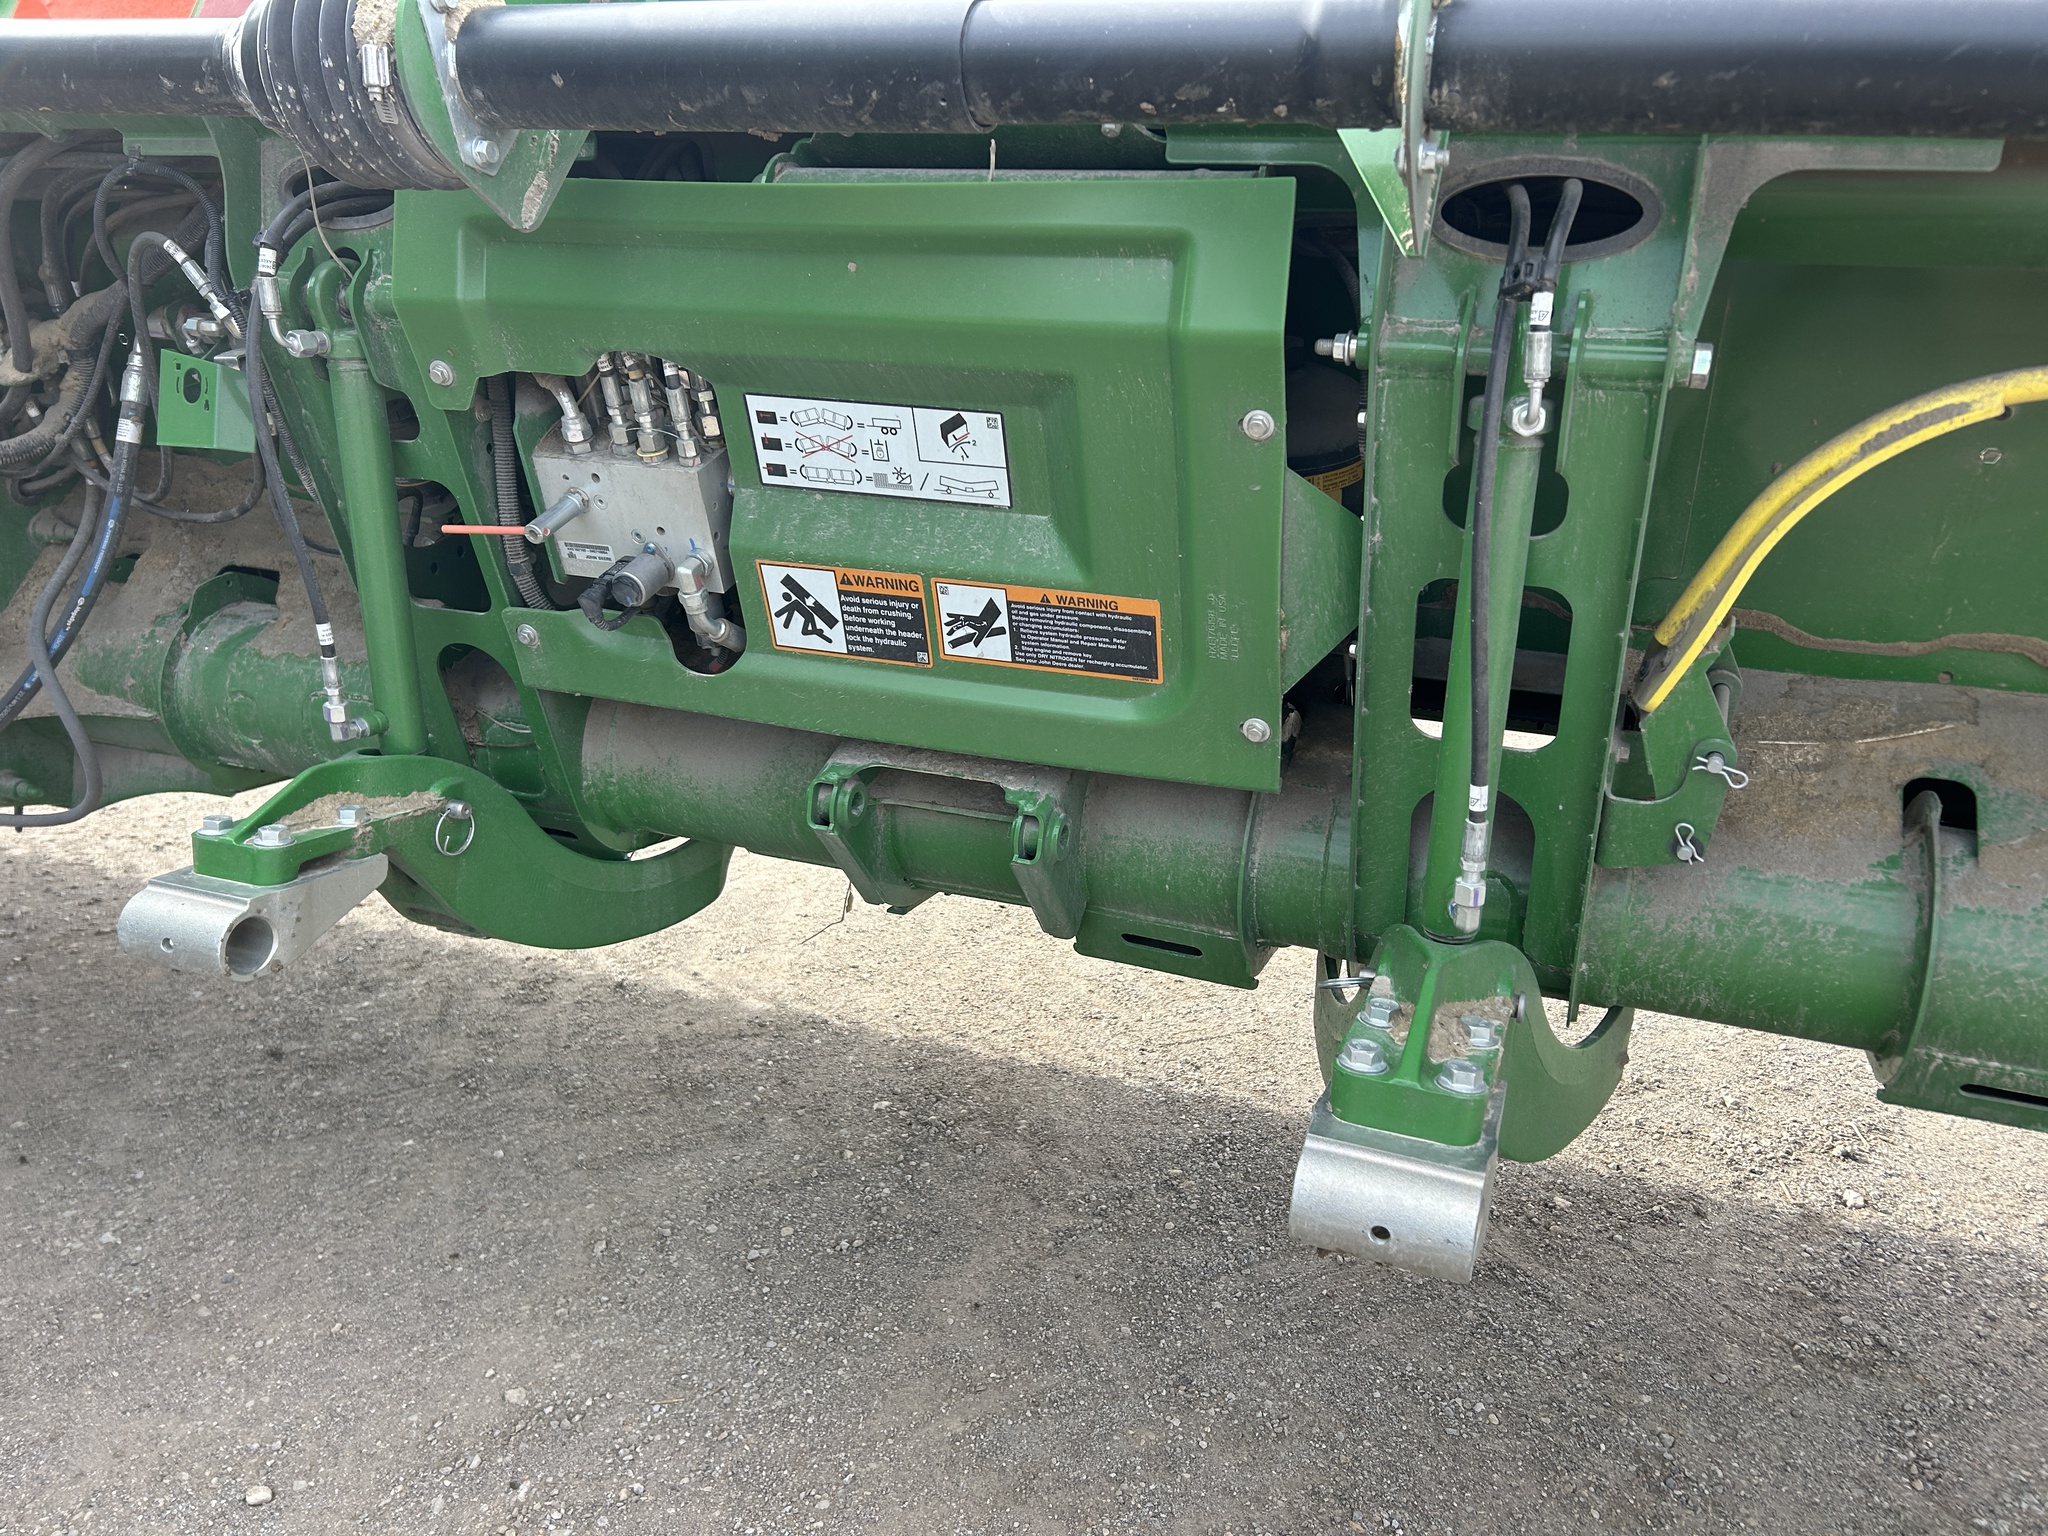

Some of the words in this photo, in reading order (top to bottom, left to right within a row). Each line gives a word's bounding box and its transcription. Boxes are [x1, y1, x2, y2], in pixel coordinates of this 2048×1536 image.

[853, 574, 919, 592] WARNING
[841, 594, 860, 603] Avoid
[862, 598, 887, 606] serious
[889, 600, 909, 609] injury
[1056, 595, 1118, 610] WARNING
[863, 606, 879, 615] from
[881, 609, 913, 620] crushing.
[844, 614, 866, 623] Before
[868, 617, 895, 628] working
[1219, 618, 1226, 628] IN
[846, 625, 884, 636] underneath
[886, 628, 897, 637] the
[898, 630, 924, 640] header,
[1079, 623, 1112, 632] components,
[1114, 627, 1152, 636] disassembling
[847, 634, 860, 643] lock
[862, 636, 873, 644] the
[875, 637, 907, 648] hydraulic
[1219, 634, 1227, 660] MADE
[848, 644, 874, 653] system.
